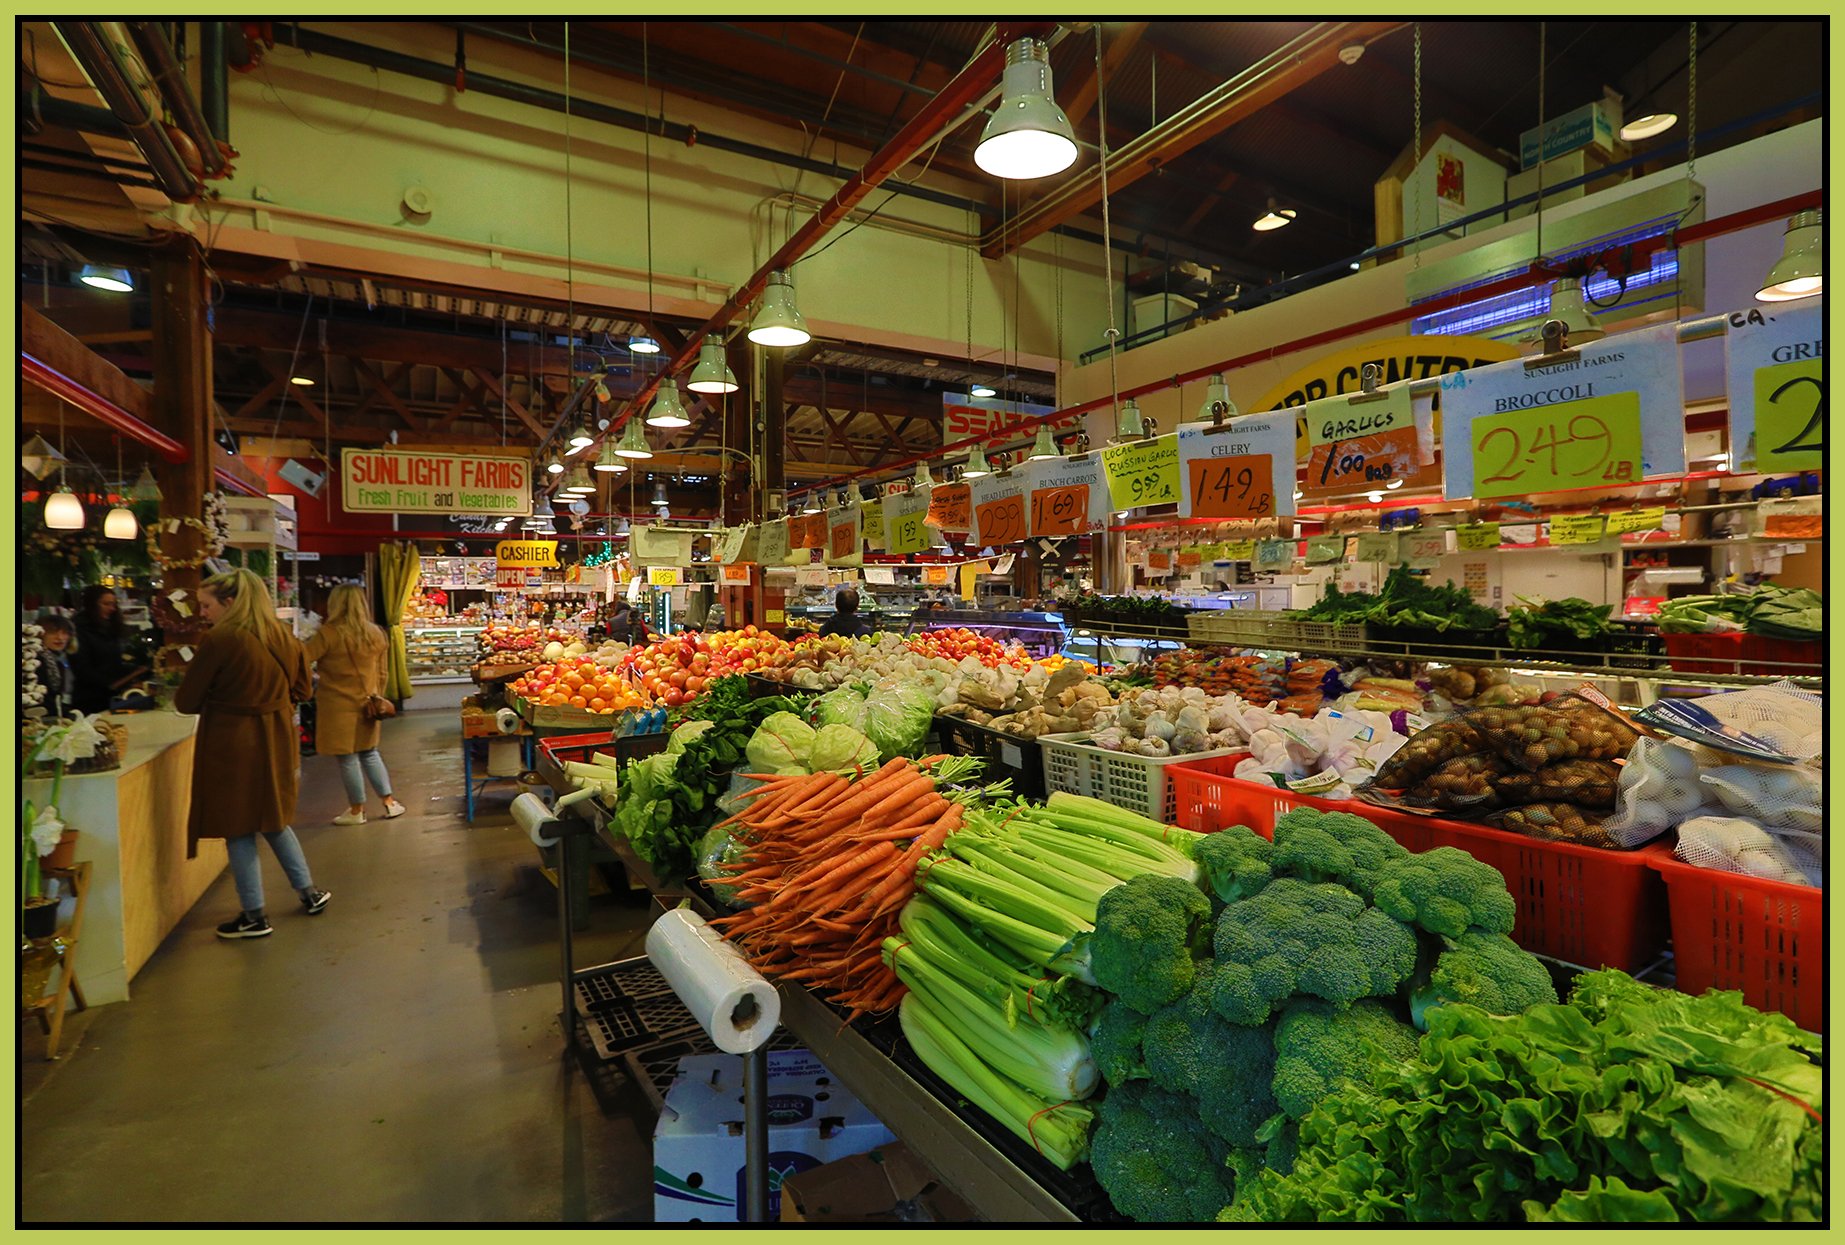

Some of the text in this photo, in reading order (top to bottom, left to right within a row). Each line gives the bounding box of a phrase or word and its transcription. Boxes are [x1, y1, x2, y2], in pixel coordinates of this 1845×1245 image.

[1523, 352, 1625, 380] SUNLIGHT FARMS
[1495, 382, 1594, 412] BROCCOLI
[1250, 423, 1271, 433] FARMS
[1321, 411, 1395, 439] GARLICS
[1104, 446, 1133, 461] LOCAL
[1211, 443, 1251, 457] CELERY
[1108, 449, 1178, 474] RUSSIAN GARLIC
[352, 455, 524, 490] SUNLIGHT FARMS
[1040, 473, 1098, 489] BUNCH CARROTS
[358, 488, 518, 509] Fresh Fruit and Vegetables
[981, 490, 999, 503] HEAD
[1196, 467, 1270, 514] 1.49 LB
[501, 546, 550, 561] CASHIER
[497, 569, 525, 585] OPEN
